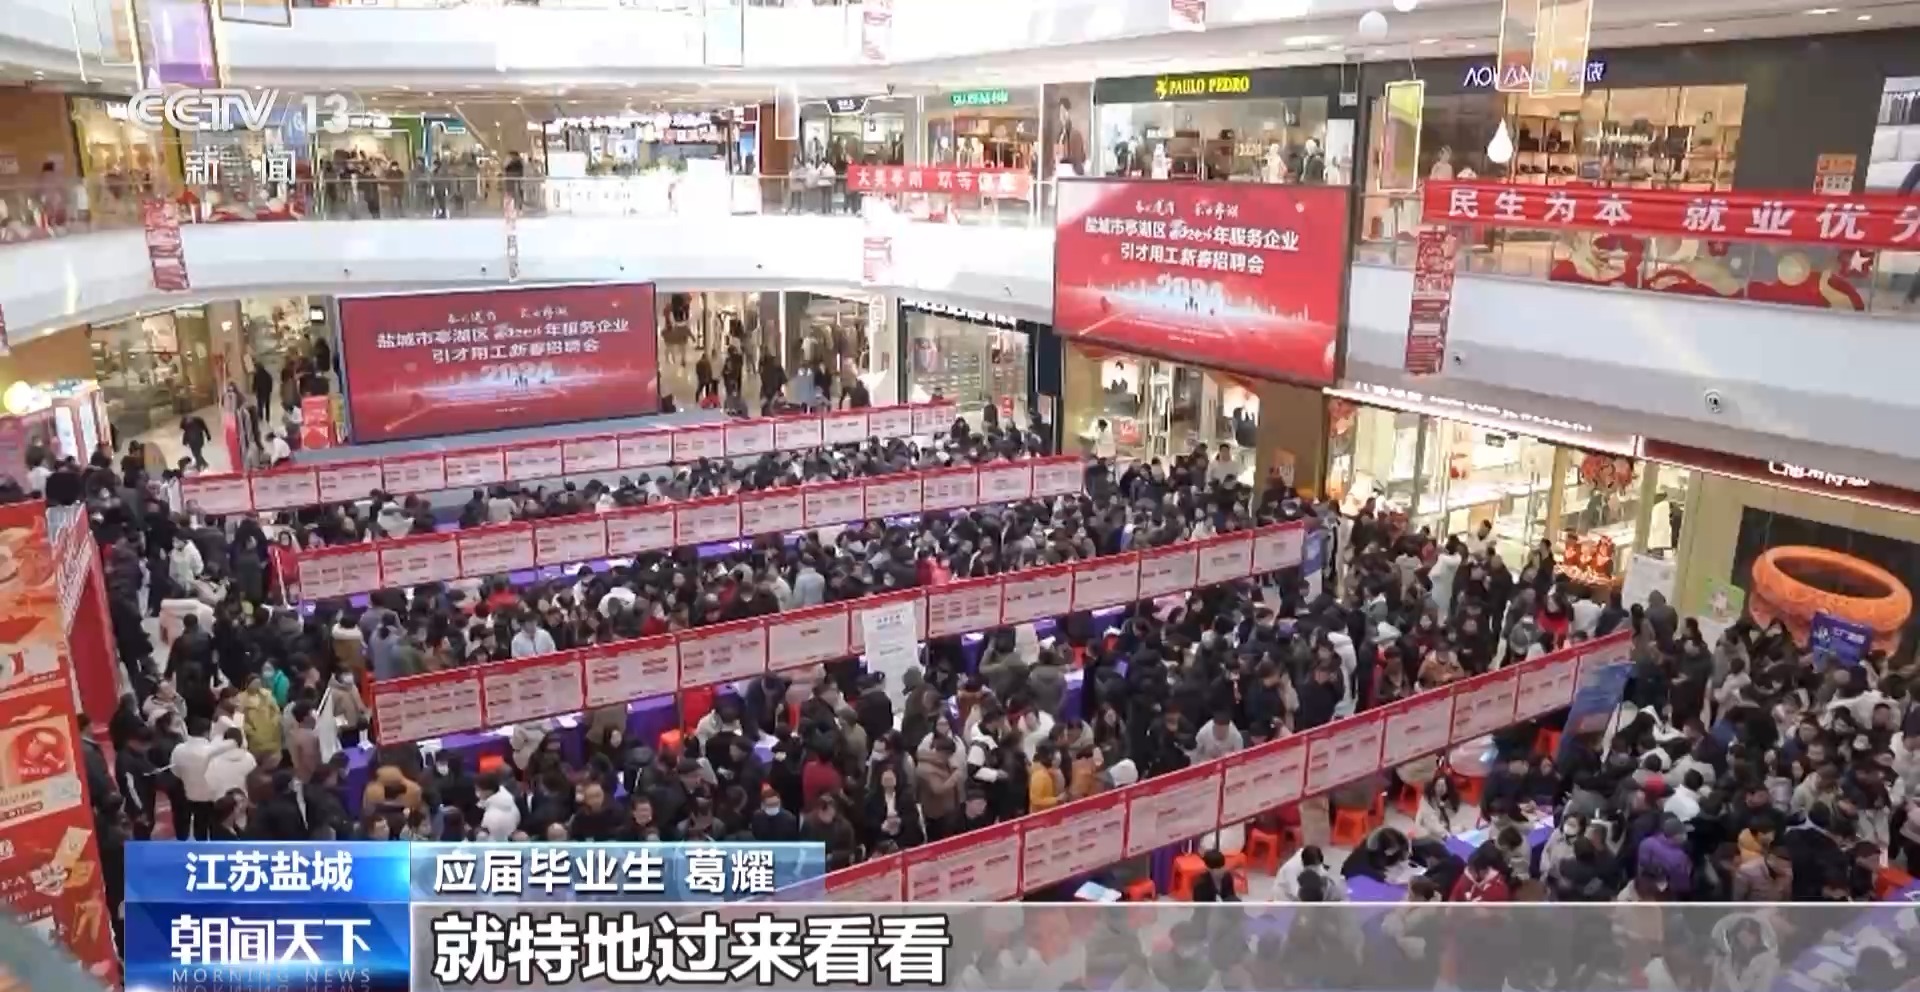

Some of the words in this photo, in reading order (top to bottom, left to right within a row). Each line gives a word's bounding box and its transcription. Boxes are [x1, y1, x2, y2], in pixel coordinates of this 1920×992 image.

[1169, 78, 1205, 95] PAULO
[1208, 76, 1250, 93] PEDRO
[1448, 188, 1632, 227] 民生为本
